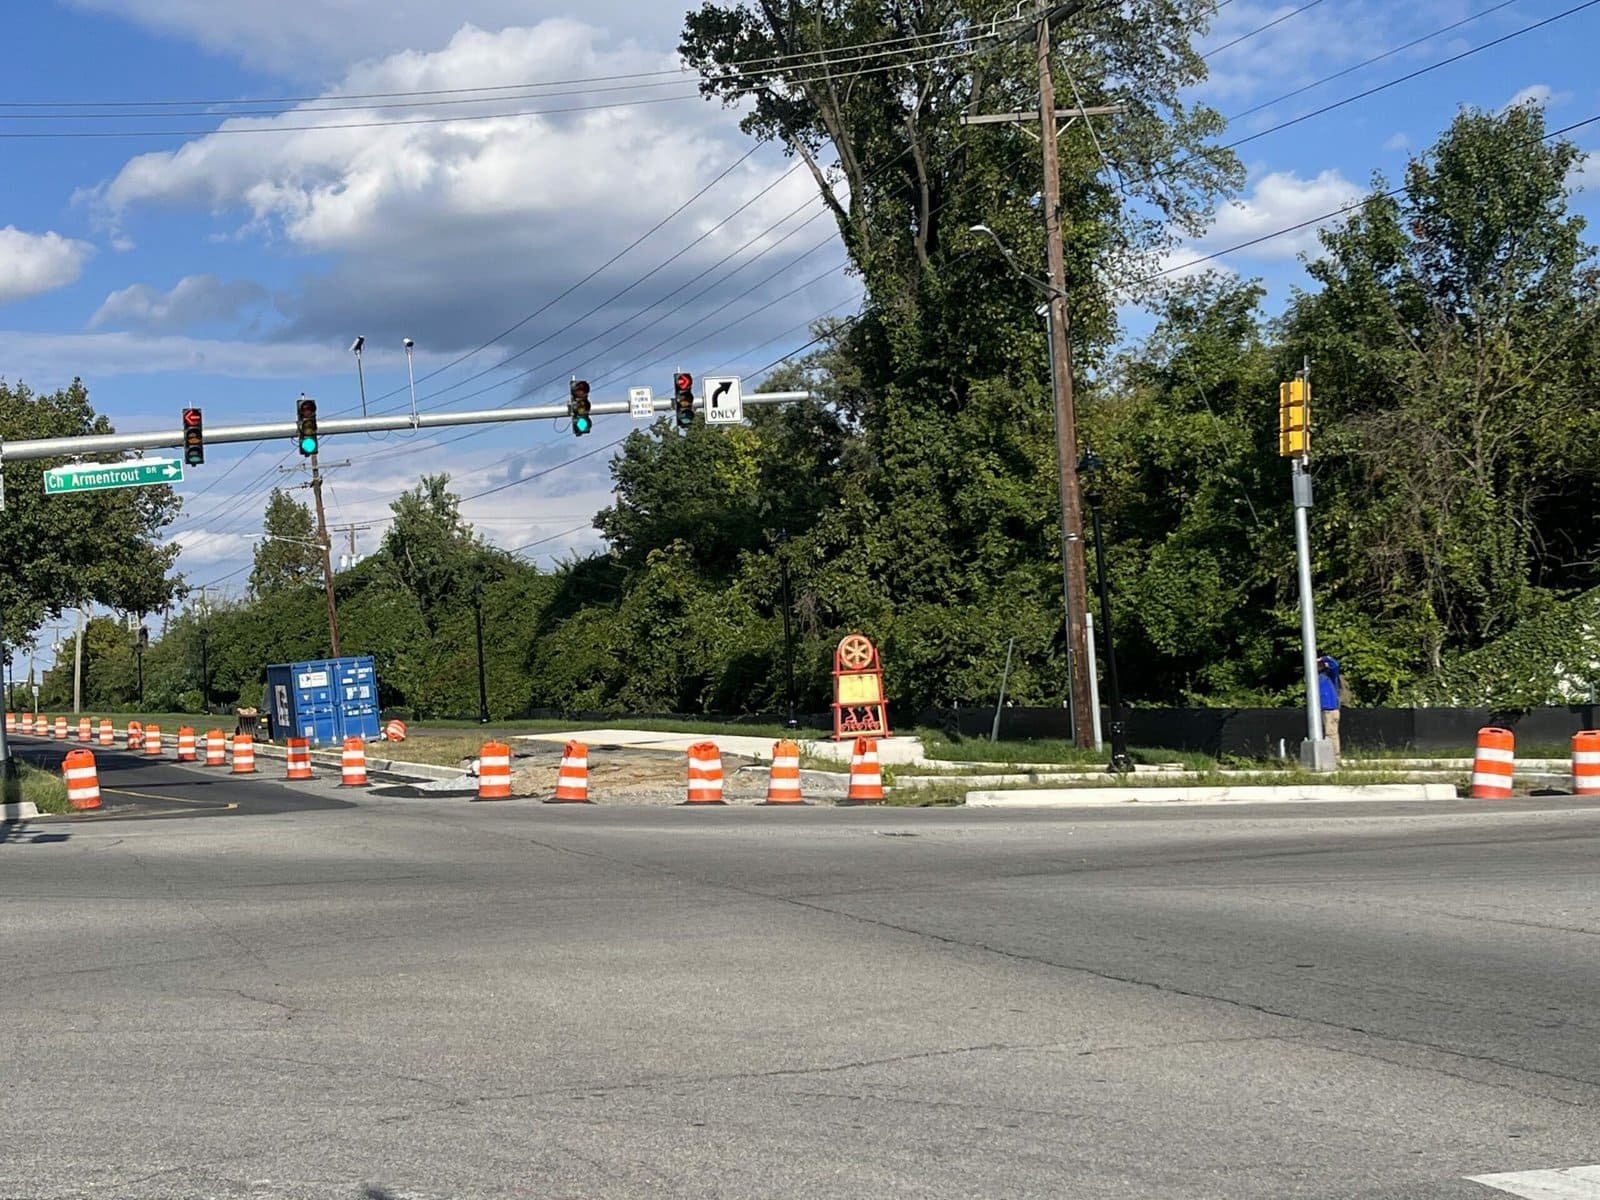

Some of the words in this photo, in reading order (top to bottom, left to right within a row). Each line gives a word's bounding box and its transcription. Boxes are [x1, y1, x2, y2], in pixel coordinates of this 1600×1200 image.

[710, 410, 736, 419] ONLY
[49, 474, 64, 488] Ch
[71, 469, 140, 486] Armentrout
[146, 466, 158, 474] DR
